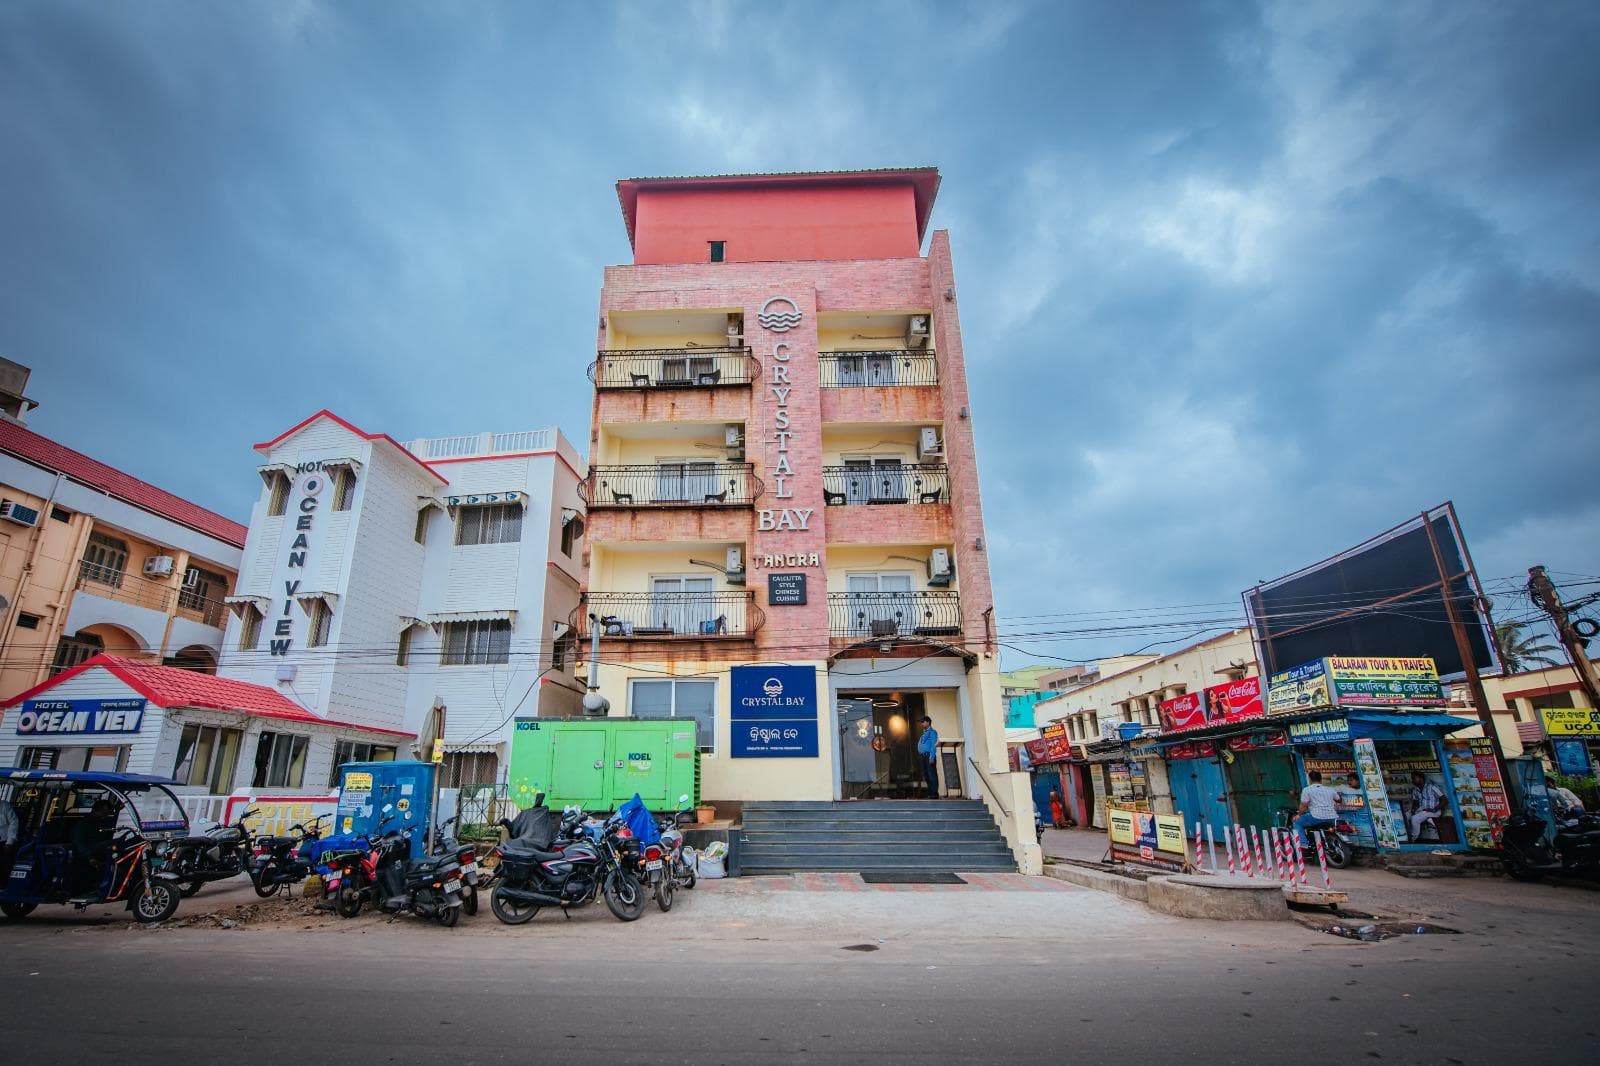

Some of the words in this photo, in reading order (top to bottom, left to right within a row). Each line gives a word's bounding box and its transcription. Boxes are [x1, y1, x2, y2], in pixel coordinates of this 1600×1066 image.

[772, 342, 794, 499] CRYSTAL
[287, 475, 323, 568] OCEAN
[757, 508, 813, 531] BAY
[753, 553, 819, 569] TANGRA
[270, 580, 300, 656] VIEW
[1288, 670, 1300, 679] Tour
[1304, 662, 1322, 673] Travels
[1332, 658, 1368, 670] BALARAM
[1369, 659, 1391, 670] TOUR
[1392, 660, 1398, 670] &
[1400, 659, 1433, 670] TRAVELS
[741, 697, 784, 706] CRYSTAL
[786, 697, 805, 706] BAY
[18, 711, 90, 732] OCEAN
[94, 710, 142, 731] VIEW
[517, 722, 541, 731] KOEL
[628, 752, 652, 761] KOEL
[1306, 760, 1341, 770] BALARAM
[1409, 761, 1440, 770] TRAVELS
